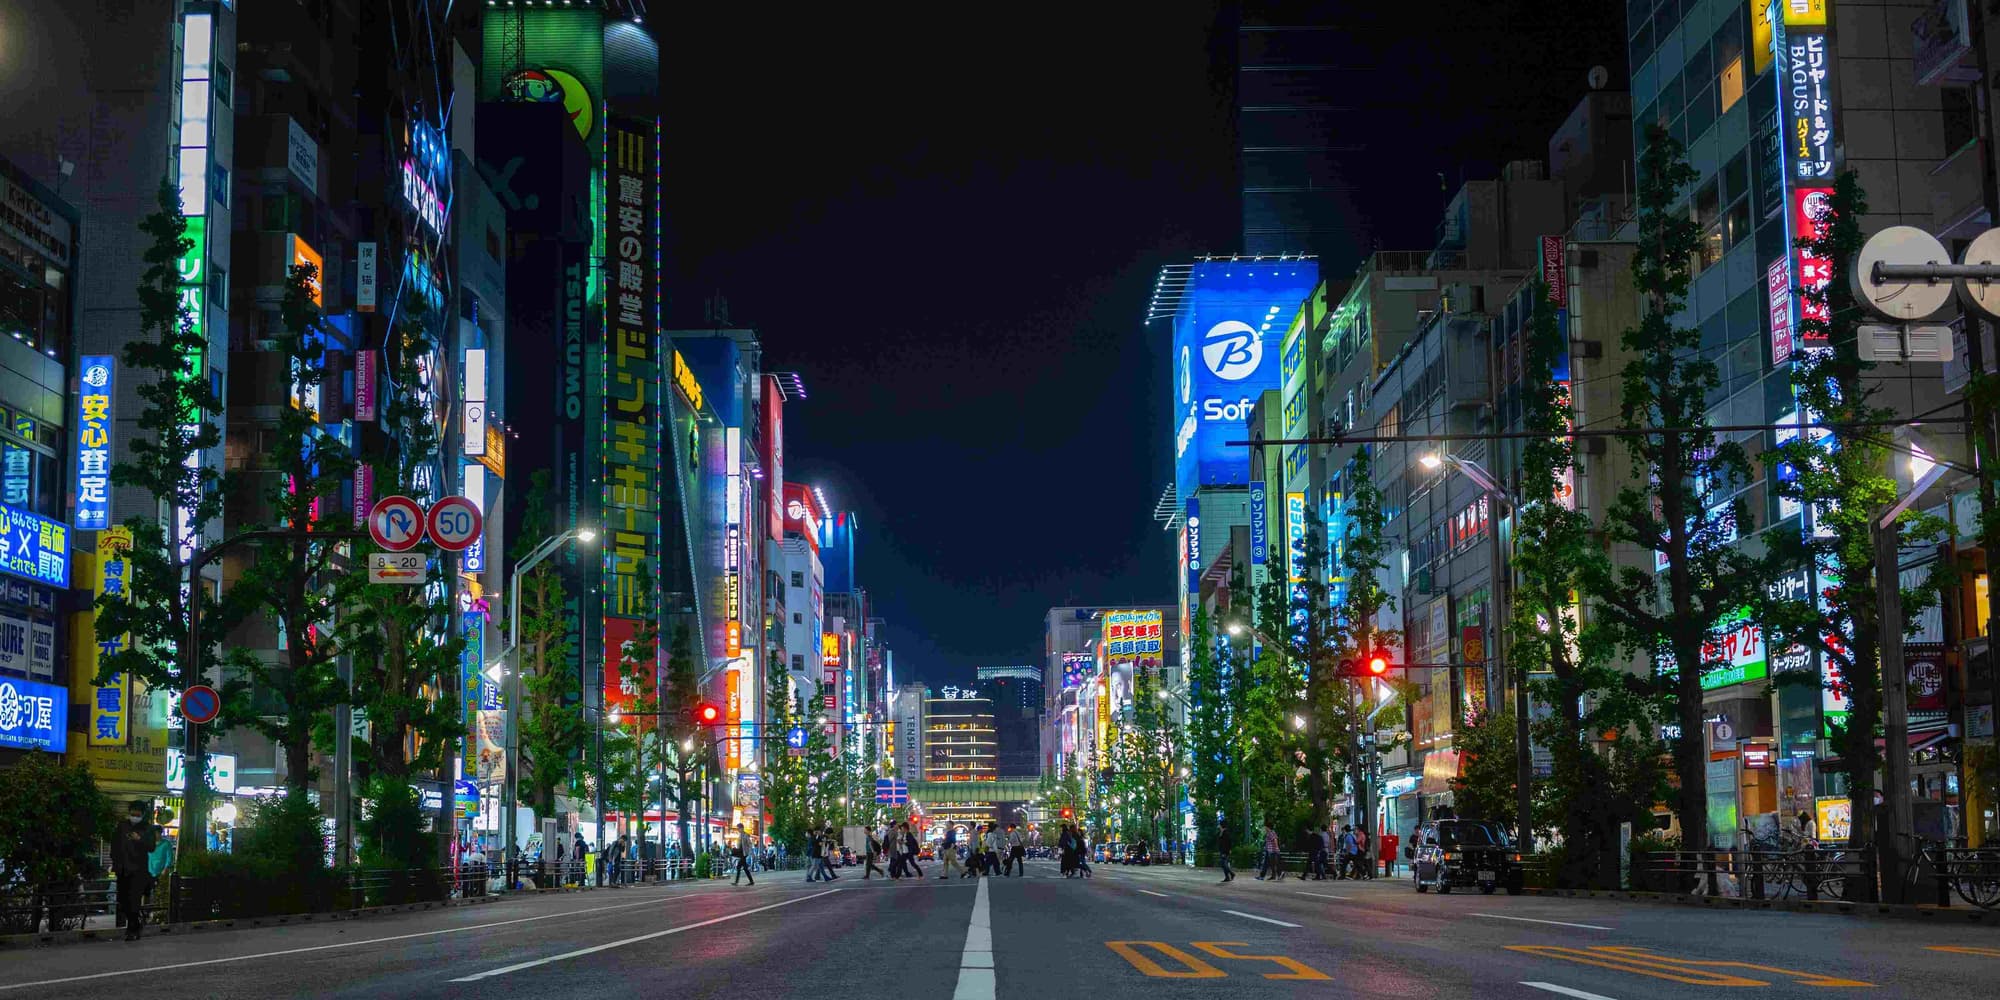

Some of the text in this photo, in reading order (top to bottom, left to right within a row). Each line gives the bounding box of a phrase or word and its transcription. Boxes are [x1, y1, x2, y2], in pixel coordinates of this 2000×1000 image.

[1797, 118, 1811, 158] バグース
[1799, 162, 1813, 175] 5F
[361, 247, 373, 286] 僕と猫
[616, 174, 644, 326] 驚安の殿堂
[564, 261, 580, 418] TSUKUMO
[79, 394, 110, 503] 安心査定
[614, 326, 648, 572] ドン・キホーテ
[11, 511, 39, 532] なんでも
[39, 520, 66, 554] 高価
[440, 511, 470, 534] 50
[1253, 503, 1265, 544] ソフマップ
[1189, 527, 1200, 559] ソフマップ
[10, 555, 38, 577] どれでも
[38, 550, 65, 584] 買取
[378, 558, 386, 567] 8
[402, 558, 416, 567] 20
[0, 622, 25, 657] URE
[32, 629, 52, 647] PLASTIC
[1109, 624, 1161, 639] 激安販売
[1742, 624, 1760, 657] 2F
[33, 644, 49, 662] MODEL
[1109, 640, 1161, 657] 高額買取
[1772, 653, 1811, 672] ダーツショップ
[0, 682, 53, 732] 駿河屋
